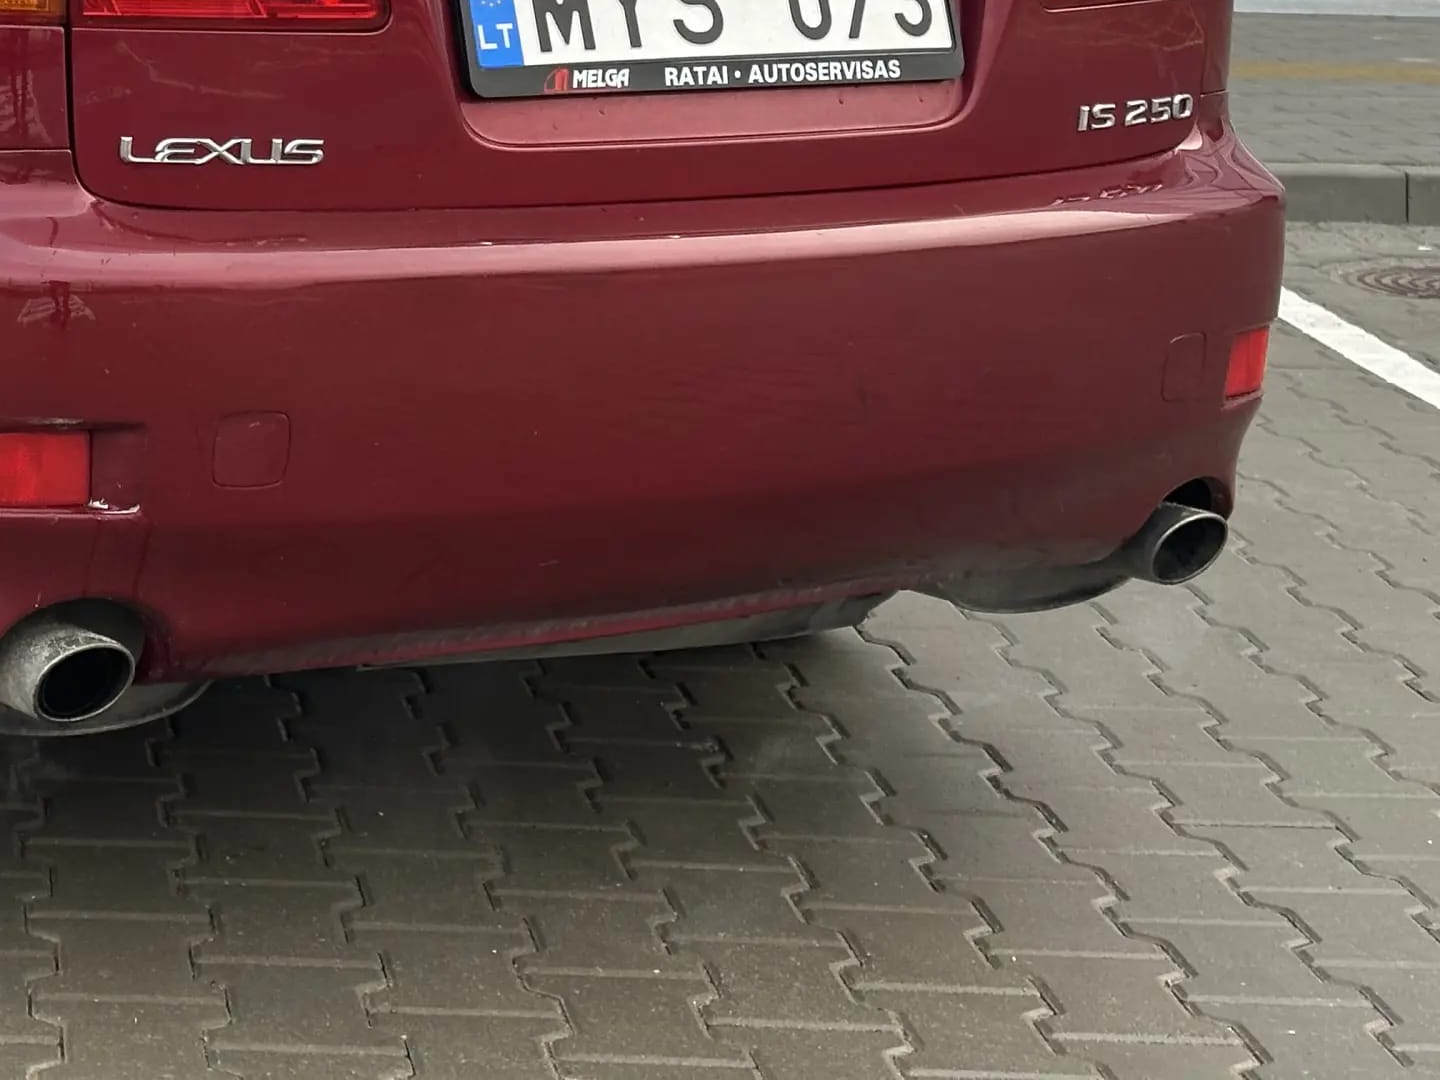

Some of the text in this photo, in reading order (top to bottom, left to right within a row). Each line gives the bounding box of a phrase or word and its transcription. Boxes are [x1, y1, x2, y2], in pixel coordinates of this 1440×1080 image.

[476, 22, 514, 51] LT
[572, 59, 902, 89] MELGA RATAI AUTOSERVISAS
[1077, 93, 1194, 132] IS 250
[119, 136, 325, 166] LEXUS
